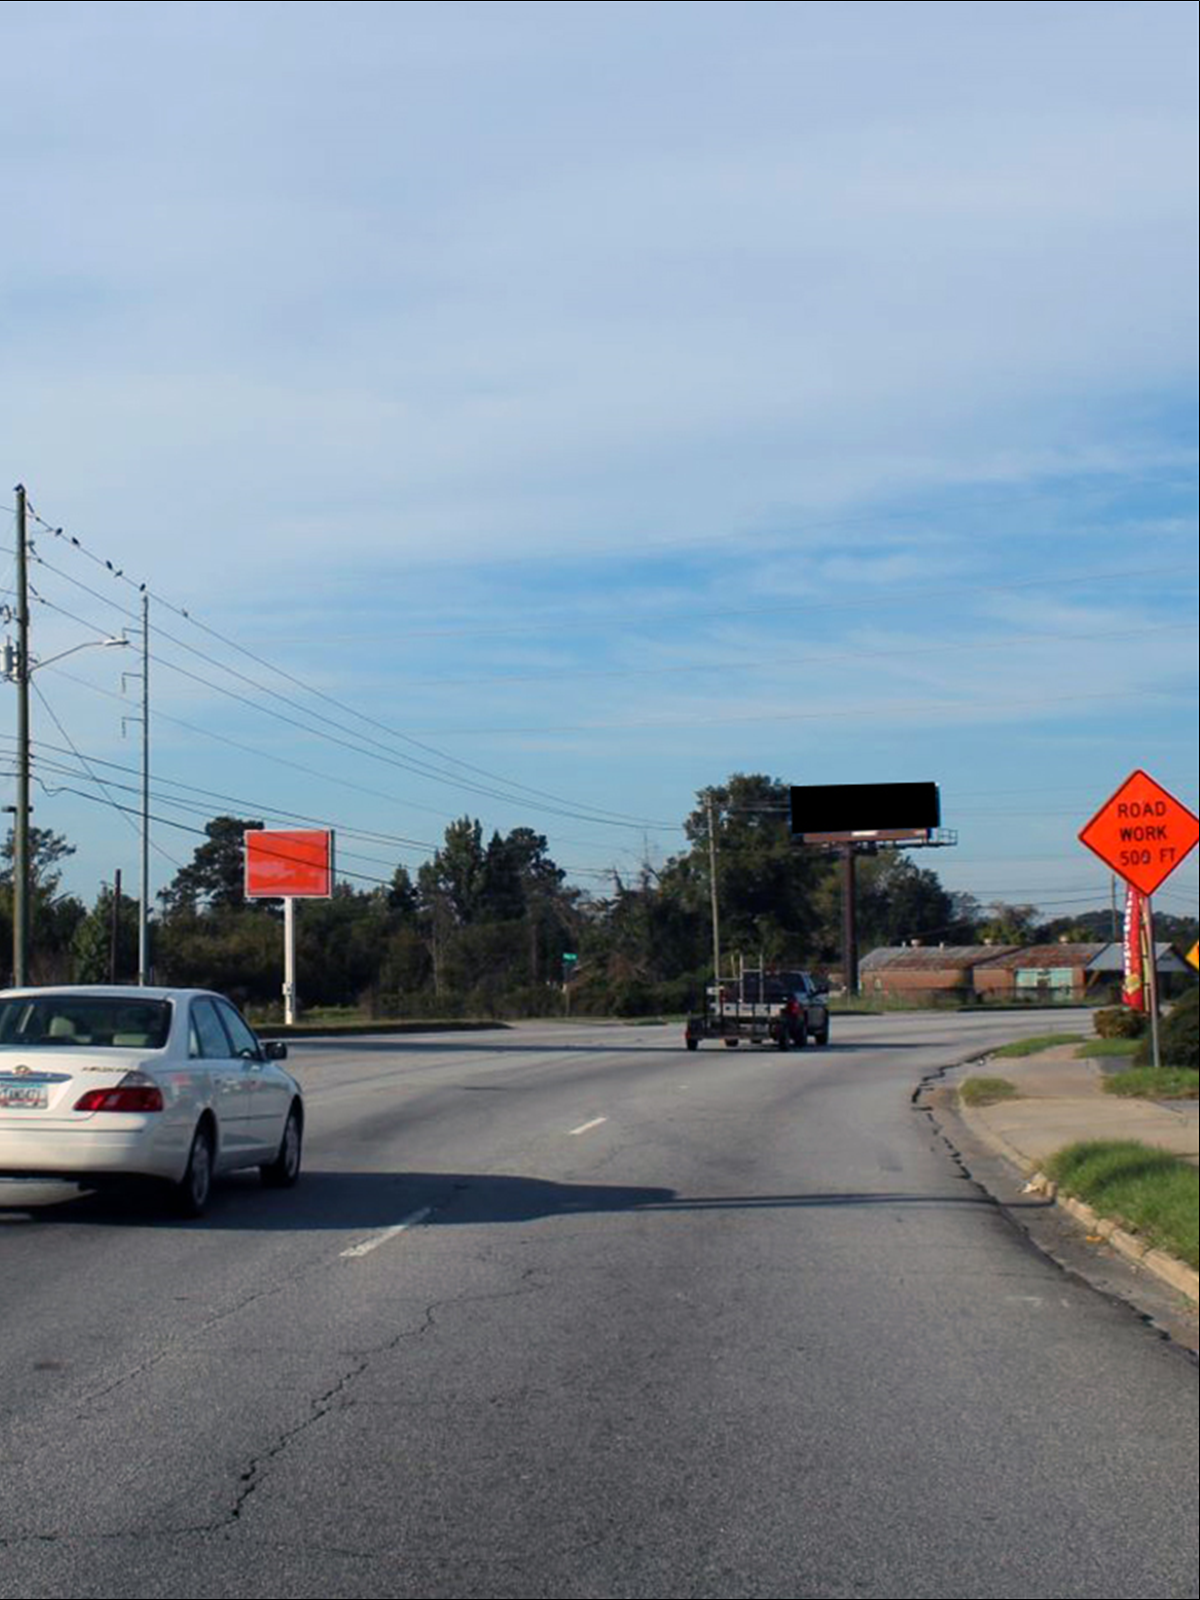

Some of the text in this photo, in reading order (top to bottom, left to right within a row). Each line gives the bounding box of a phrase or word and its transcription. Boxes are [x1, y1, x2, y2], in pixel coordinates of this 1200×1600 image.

[1117, 801, 1167, 818] ROAD
[1120, 825, 1167, 842] WORK
[1120, 847, 1176, 867] 500 FT
